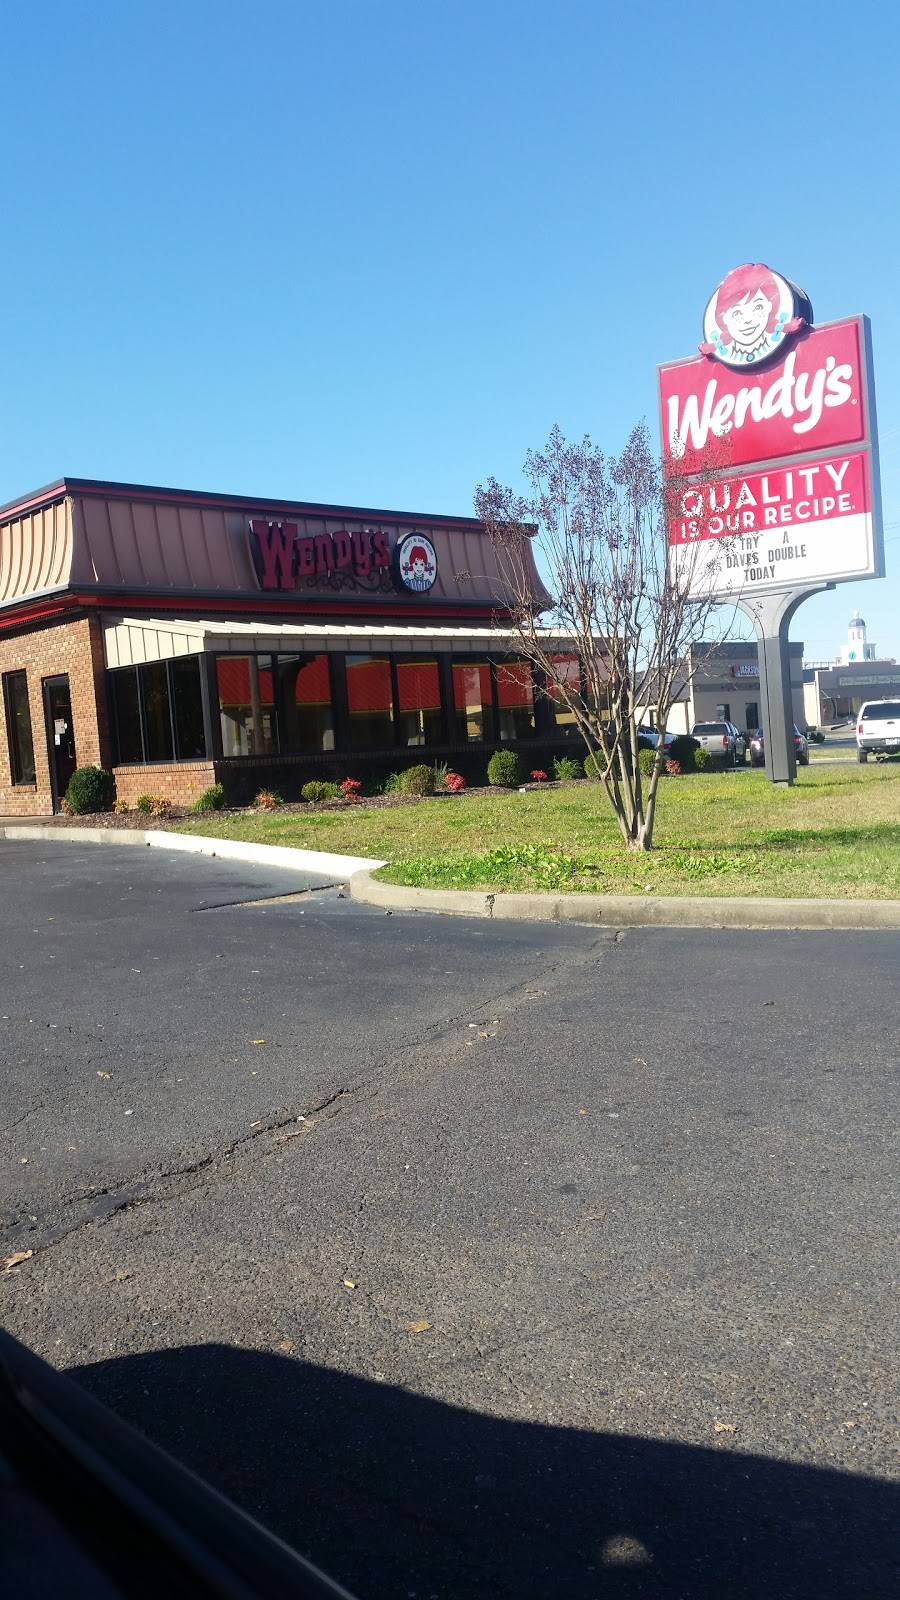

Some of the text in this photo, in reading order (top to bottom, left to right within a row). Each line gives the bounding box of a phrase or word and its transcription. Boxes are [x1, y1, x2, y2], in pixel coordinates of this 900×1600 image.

[667, 351, 853, 460] Wendy's
[681, 461, 850, 518] QUALITY
[681, 521, 700, 539] IS
[708, 511, 755, 533] OUR
[740, 530, 790, 551] TRY A
[768, 544, 807, 562] DOUBLE
[744, 565, 775, 582] TODAY
